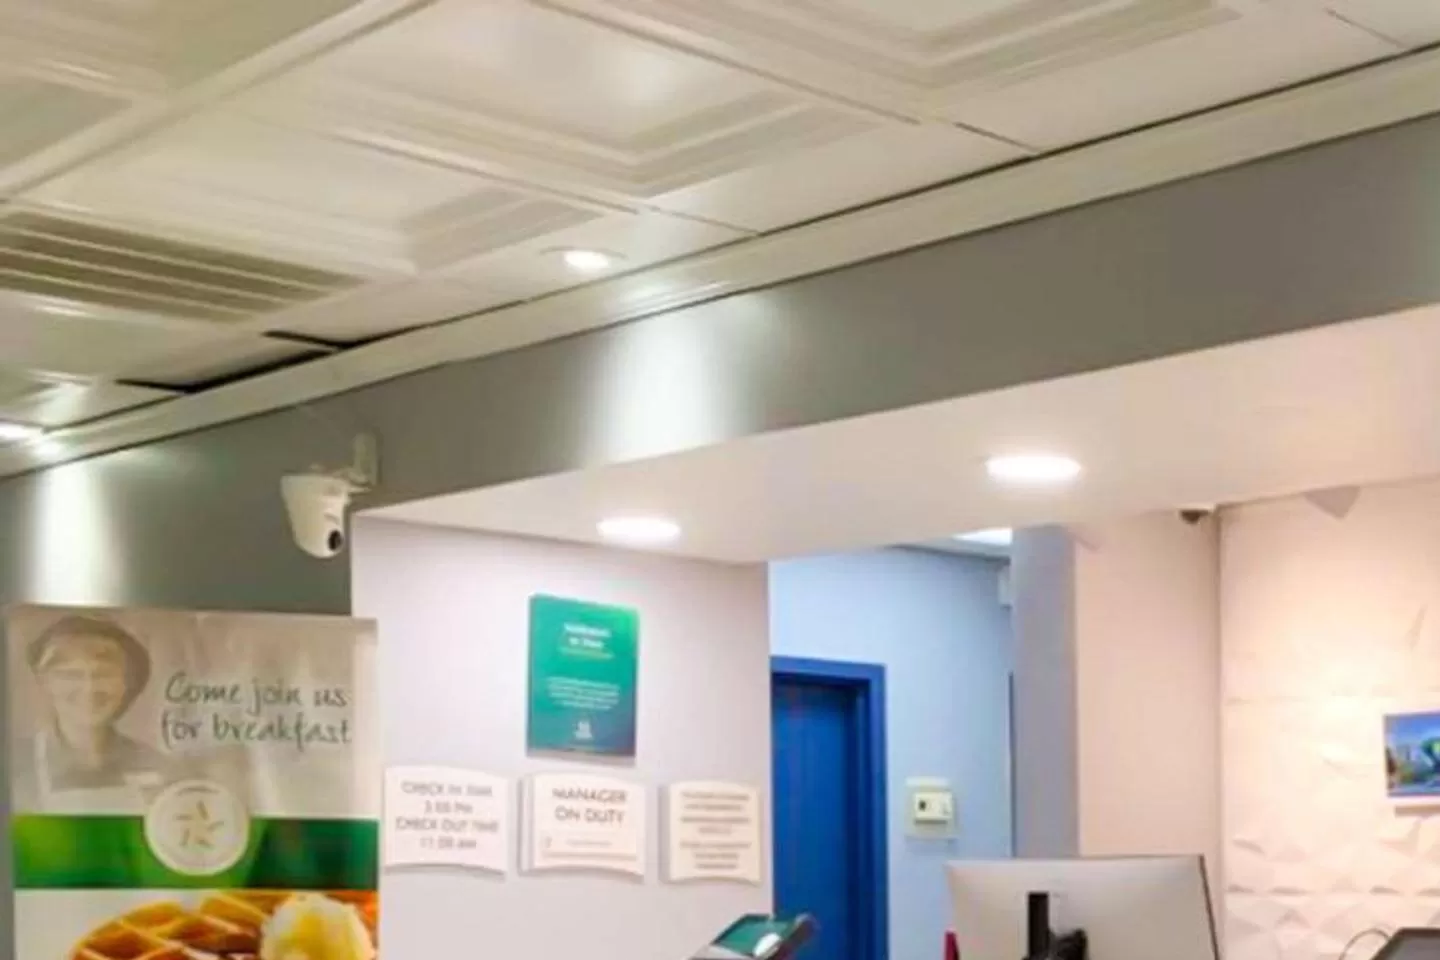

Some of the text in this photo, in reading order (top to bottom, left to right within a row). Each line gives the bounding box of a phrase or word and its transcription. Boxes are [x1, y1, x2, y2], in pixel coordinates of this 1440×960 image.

[165, 671, 349, 717] Come join us
[161, 709, 353, 753] for breakfast
[551, 787, 629, 803] MANAGER
[554, 804, 627, 826] ON DUTY
